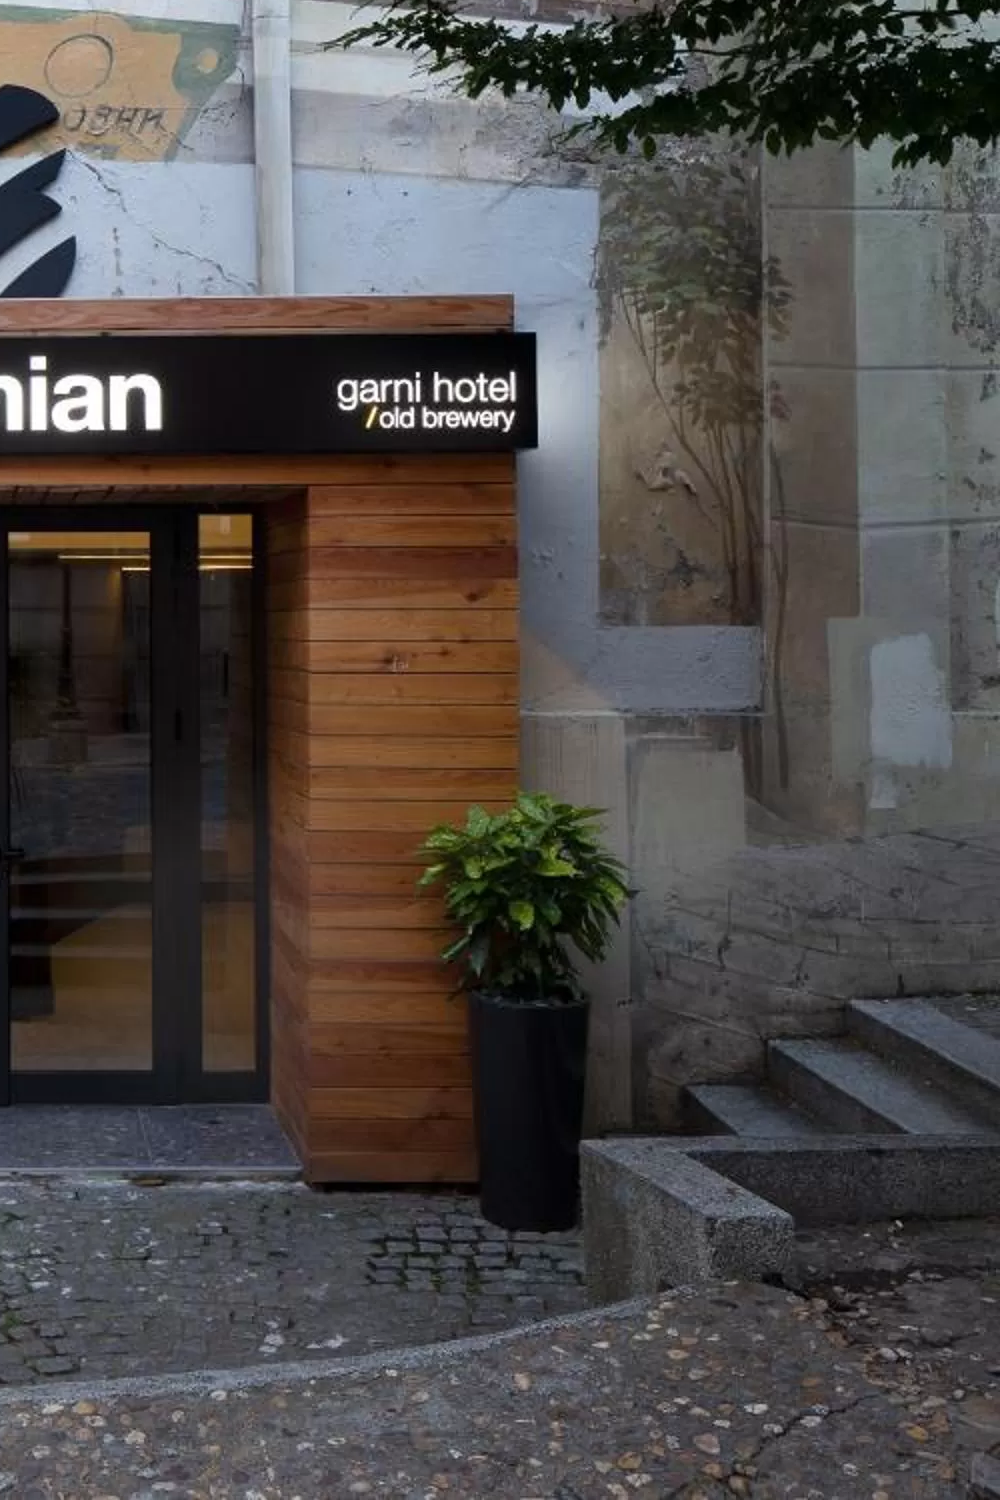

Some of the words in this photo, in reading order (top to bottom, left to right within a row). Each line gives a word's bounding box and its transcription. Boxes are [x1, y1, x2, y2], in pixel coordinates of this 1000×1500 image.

[337, 371, 421, 411] garni
[433, 371, 516, 403] hotel
[422, 405, 516, 433] brewery
